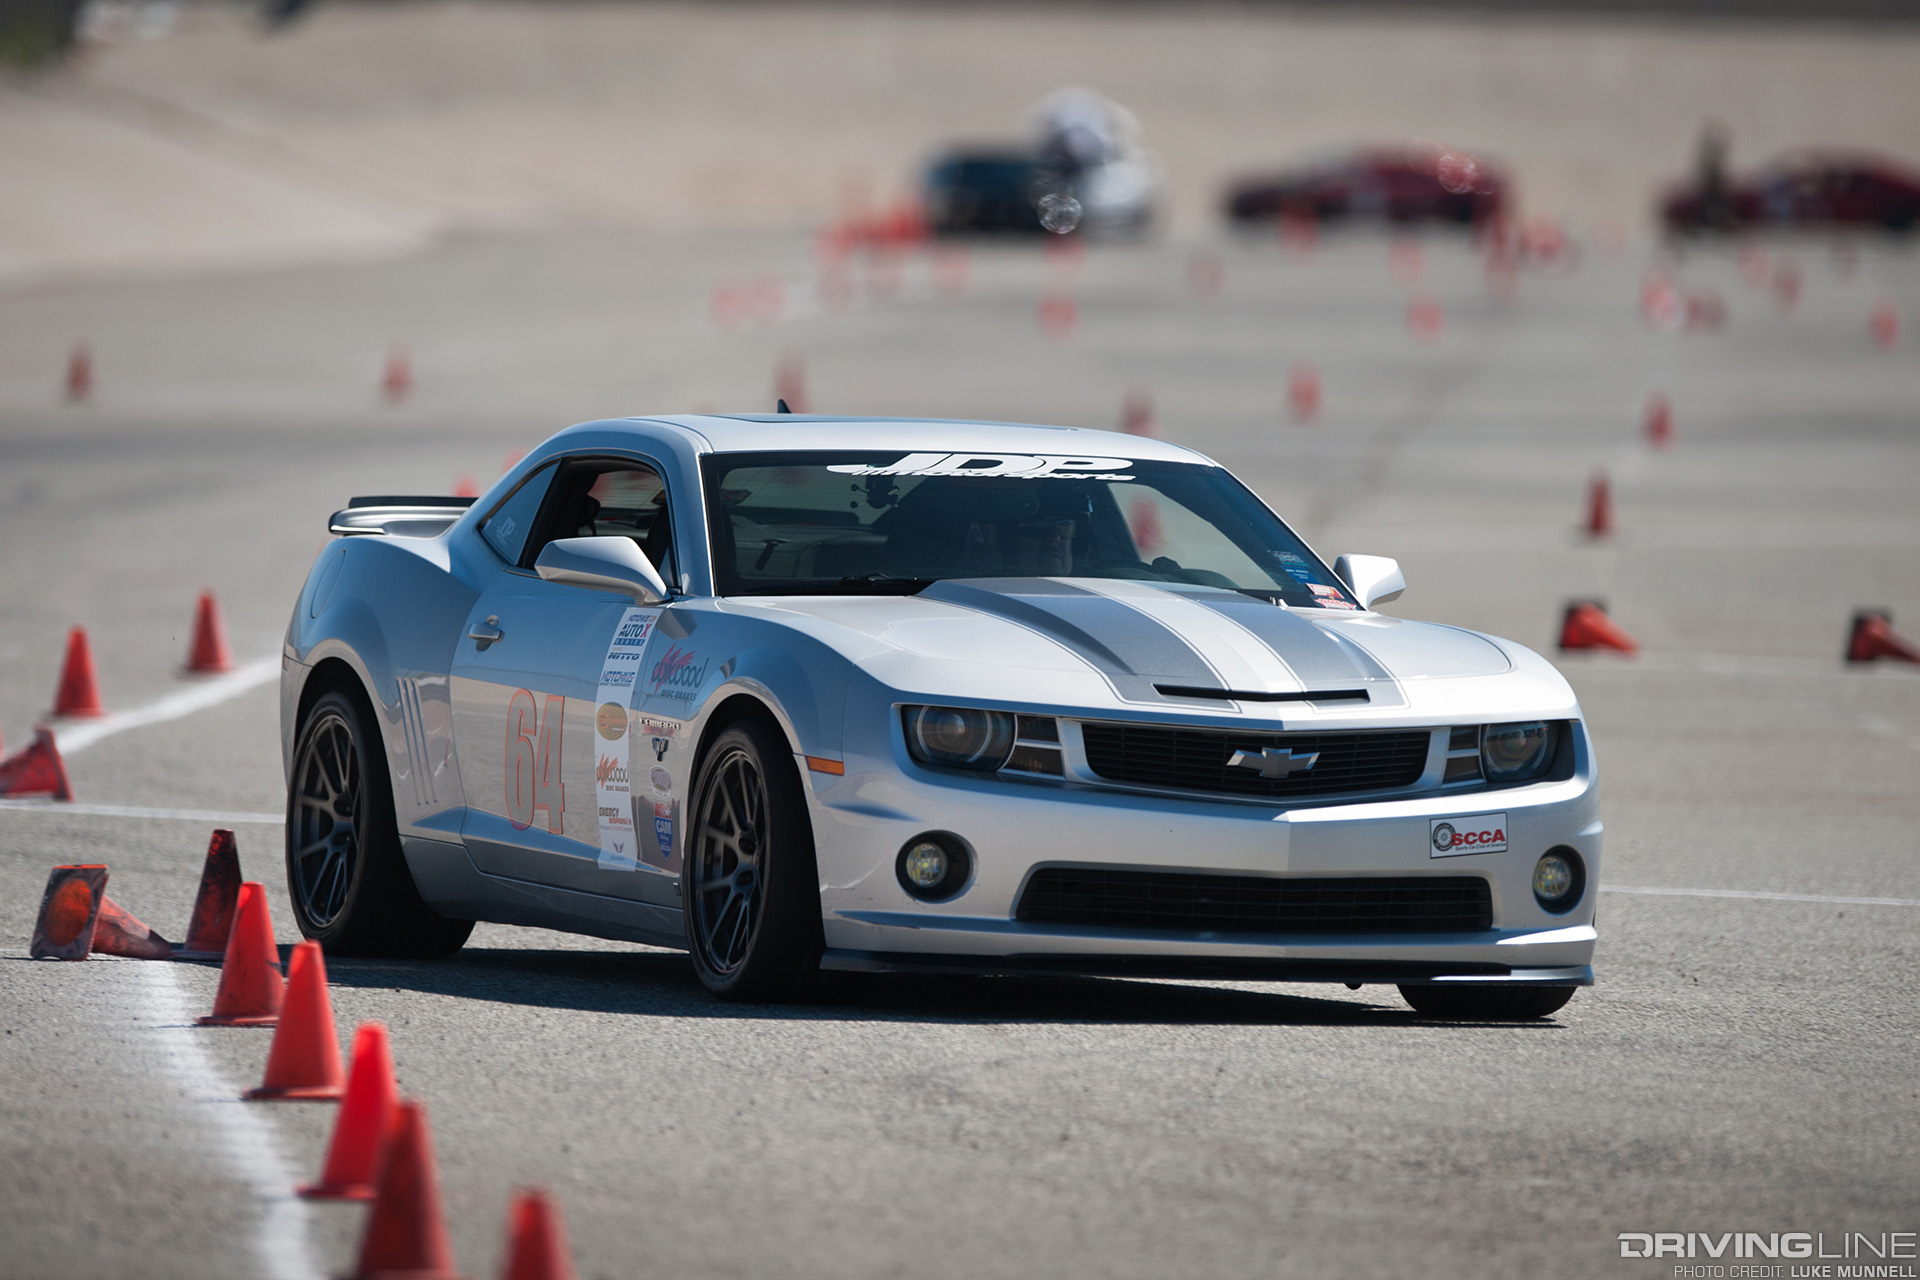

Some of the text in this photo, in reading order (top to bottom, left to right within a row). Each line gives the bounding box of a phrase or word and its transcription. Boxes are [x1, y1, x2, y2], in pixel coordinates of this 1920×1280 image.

[826, 453, 1133, 474] JDP
[607, 652, 640, 660] NITTO
[660, 689, 697, 702] DISC BRAKES
[640, 718, 681, 730] CAMARO
[505, 688, 565, 835] 64
[599, 807, 619, 817] ENERGY
[656, 820, 672, 834] CAM
[1451, 829, 1505, 846] SCCA
